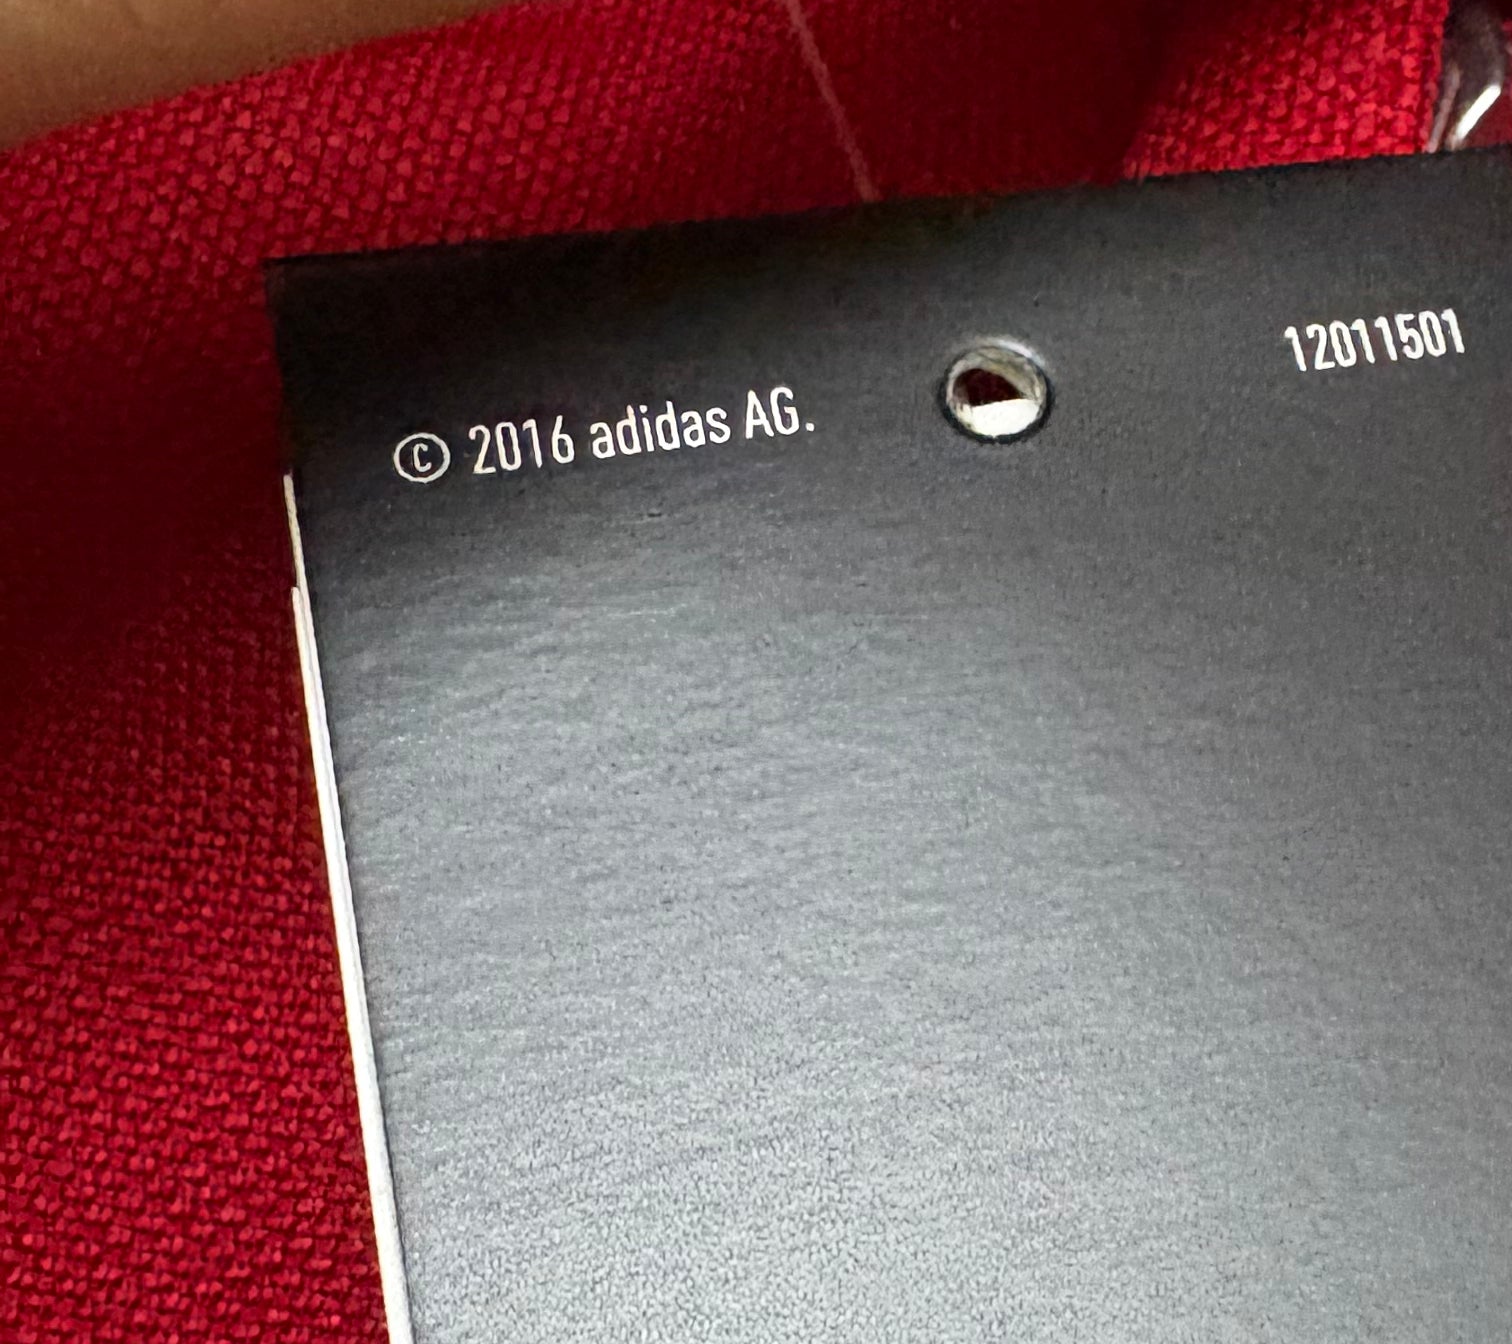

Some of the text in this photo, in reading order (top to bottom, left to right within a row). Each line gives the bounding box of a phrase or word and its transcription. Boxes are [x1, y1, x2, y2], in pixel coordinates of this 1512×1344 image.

[1284, 308, 1465, 371] 12011501
[468, 416, 575, 475] 2016
[590, 400, 732, 461] adidas
[745, 385, 816, 440] AG.
